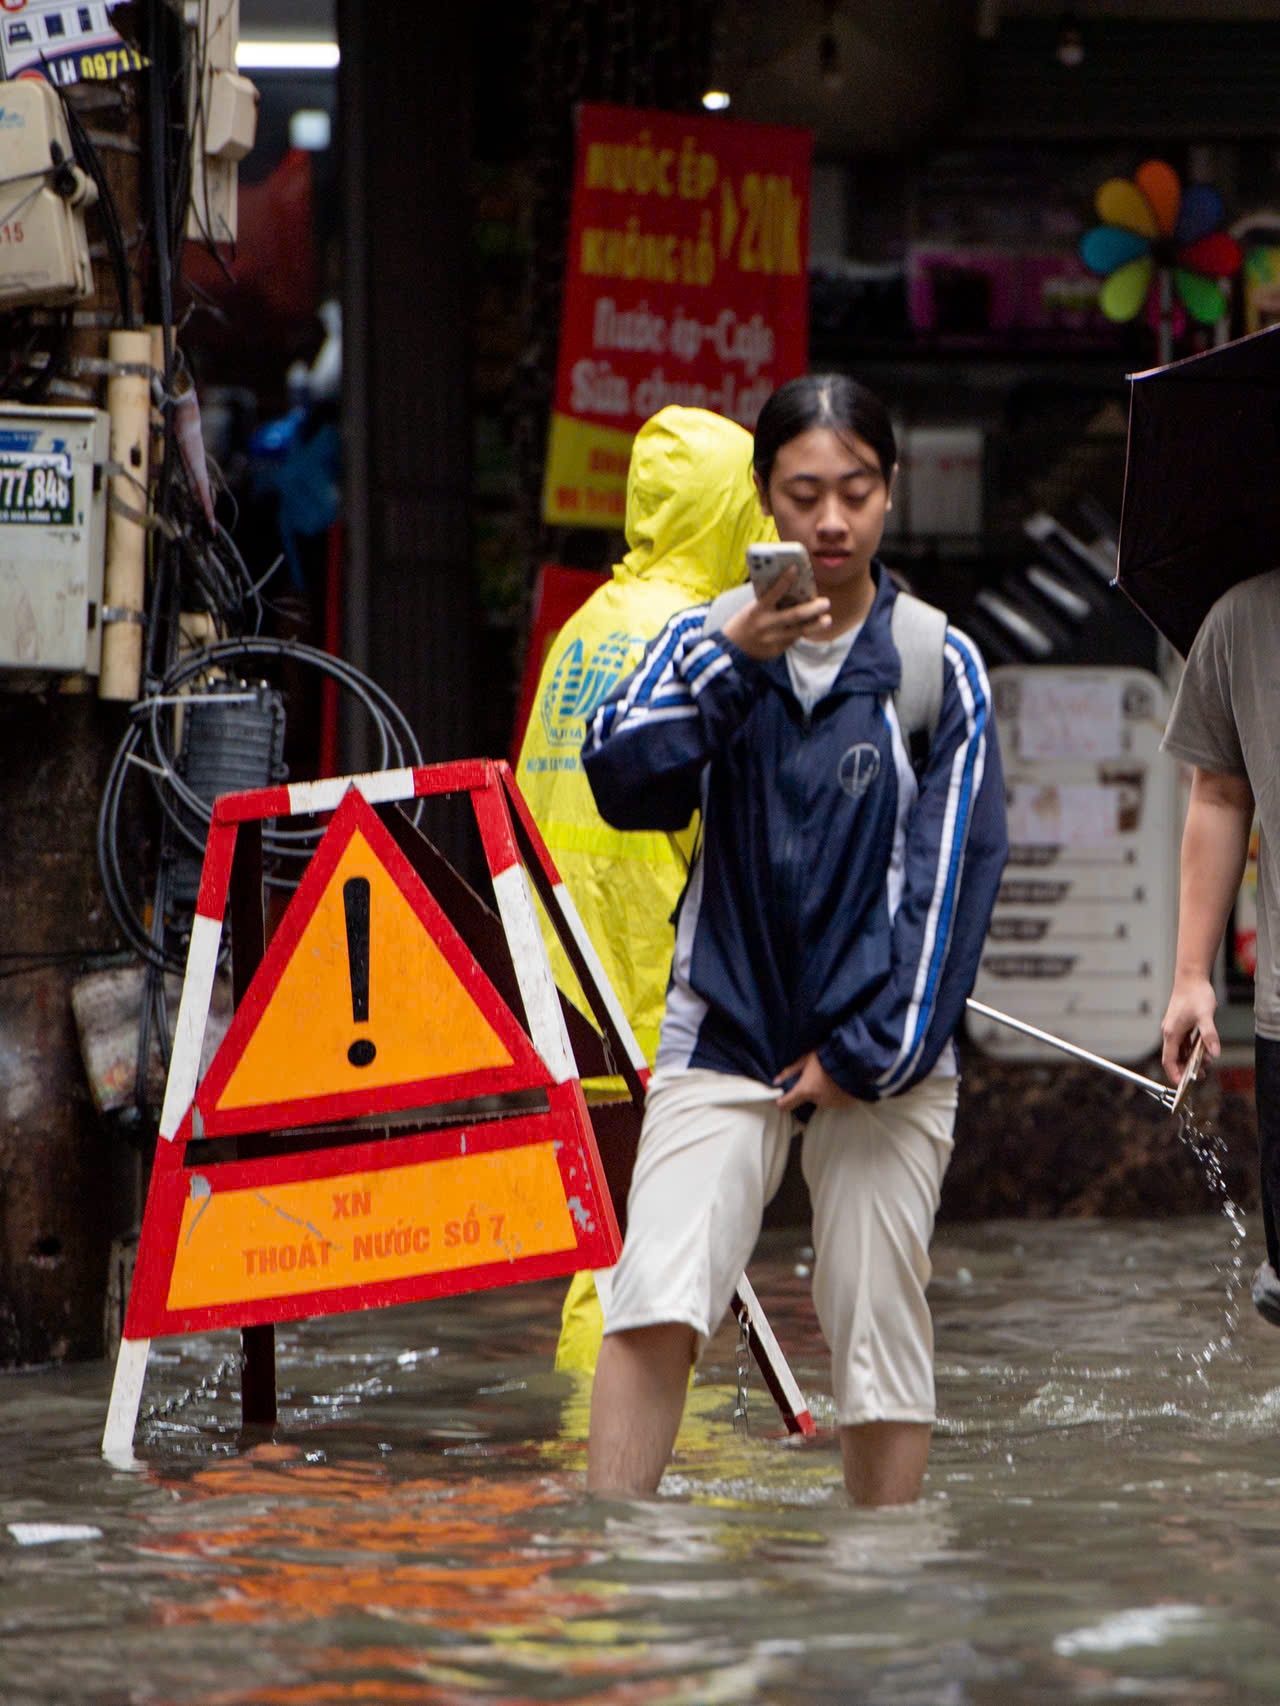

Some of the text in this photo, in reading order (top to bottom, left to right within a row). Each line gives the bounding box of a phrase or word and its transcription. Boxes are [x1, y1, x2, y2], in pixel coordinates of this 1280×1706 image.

[0, 221, 24, 243] 15
[332, 1191, 371, 1219] XN
[241, 1204, 506, 1277] THOÁT NƯỚC SỐ 7
